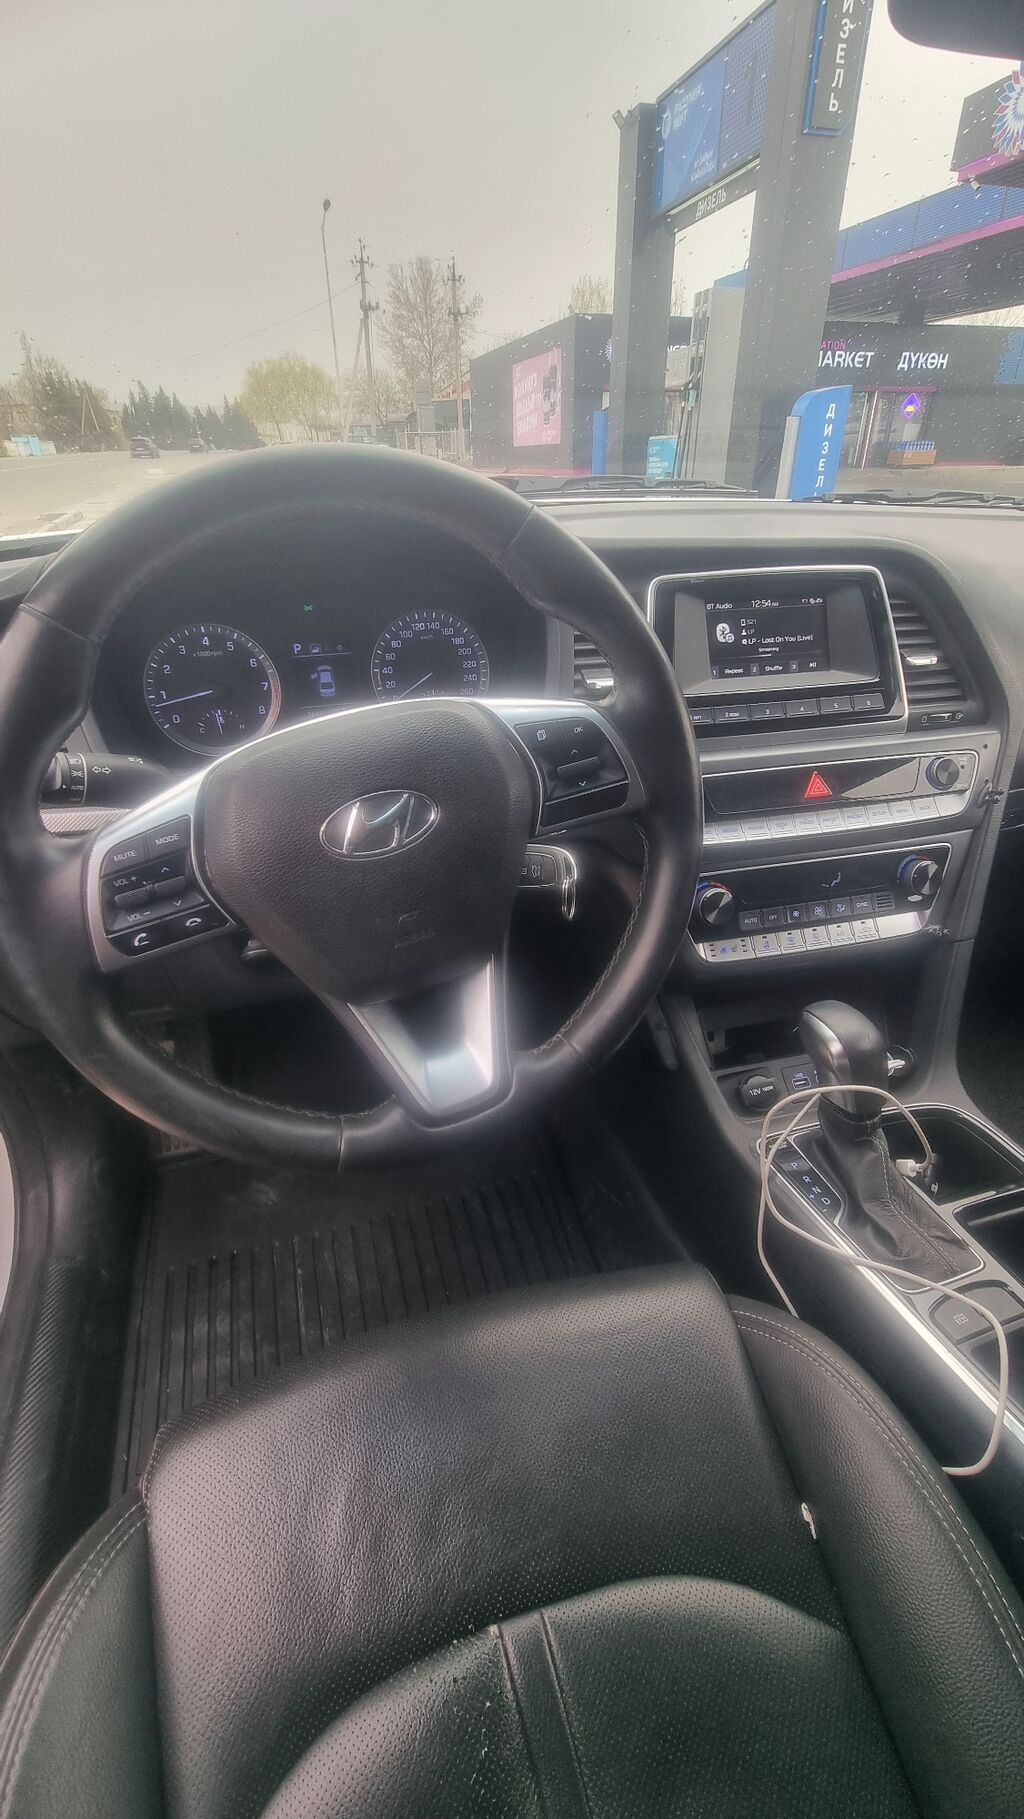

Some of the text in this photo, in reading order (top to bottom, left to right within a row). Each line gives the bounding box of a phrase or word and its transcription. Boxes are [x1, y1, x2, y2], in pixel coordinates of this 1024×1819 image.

[695, 187, 727, 220] ДИЗЕЛЬ
[814, 403, 836, 497] ДИЗЕЛ
[751, 600, 771, 608] 12:54
[426, 622, 440, 630] 140
[202, 636, 210, 646] 4
[179, 646, 186, 654] 3
[227, 642, 234, 651] 5
[293, 644, 301, 654] P
[250, 659, 257, 667] 6
[163, 665, 171, 674] 2
[261, 682, 268, 691] 7
[160, 691, 166, 699] 1
[259, 706, 266, 715] 8
[173, 715, 180, 724] 0
[155, 833, 180, 845] MODE
[114, 850, 137, 862] MUTE
[113, 878, 129, 887] VOL
[127, 913, 142, 922] VOL
[749, 1088, 760, 1096] 12V
